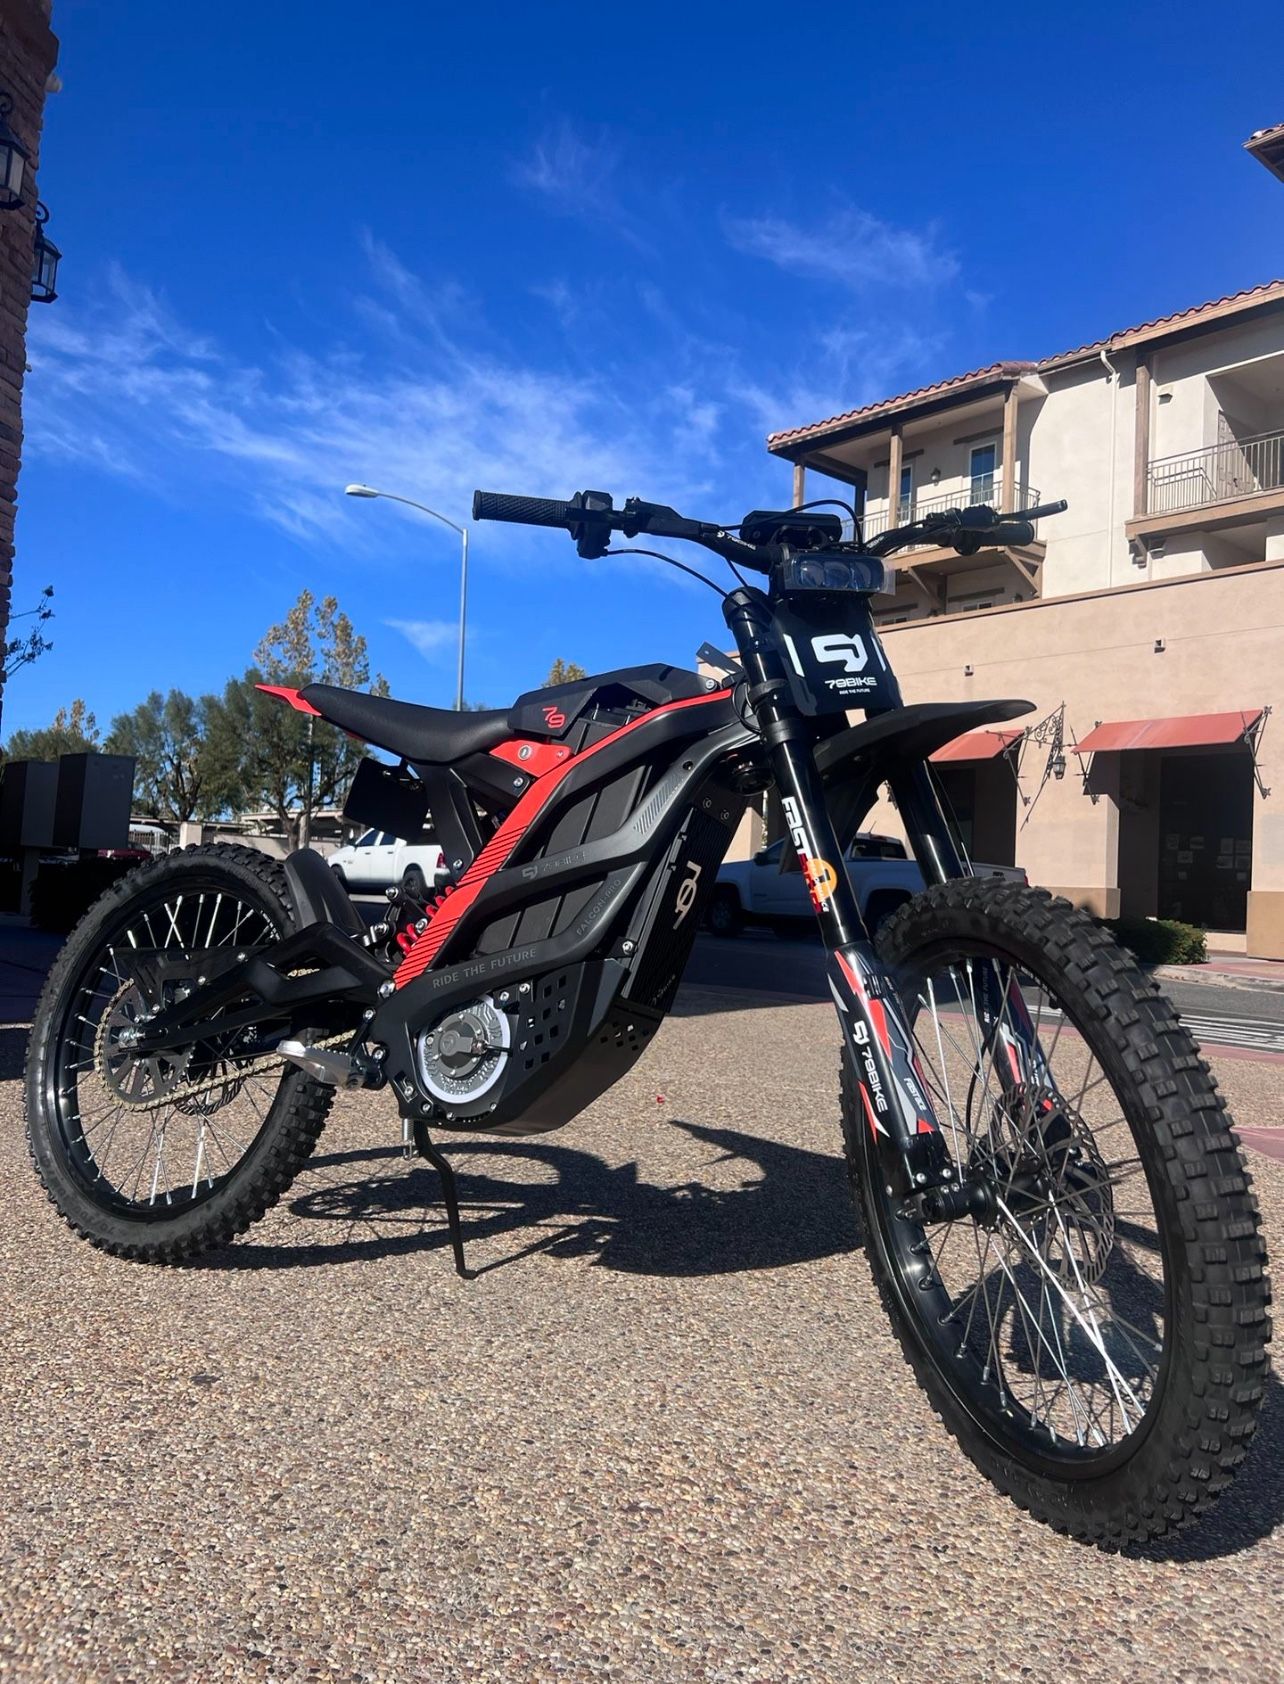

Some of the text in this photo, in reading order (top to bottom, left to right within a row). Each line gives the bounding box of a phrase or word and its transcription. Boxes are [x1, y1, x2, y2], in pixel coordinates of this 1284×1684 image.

[824, 676, 877, 689] 79BIKE
[432, 948, 537, 989] RIDE THE FUTURE
[861, 1046, 889, 1113] 79BIKE
